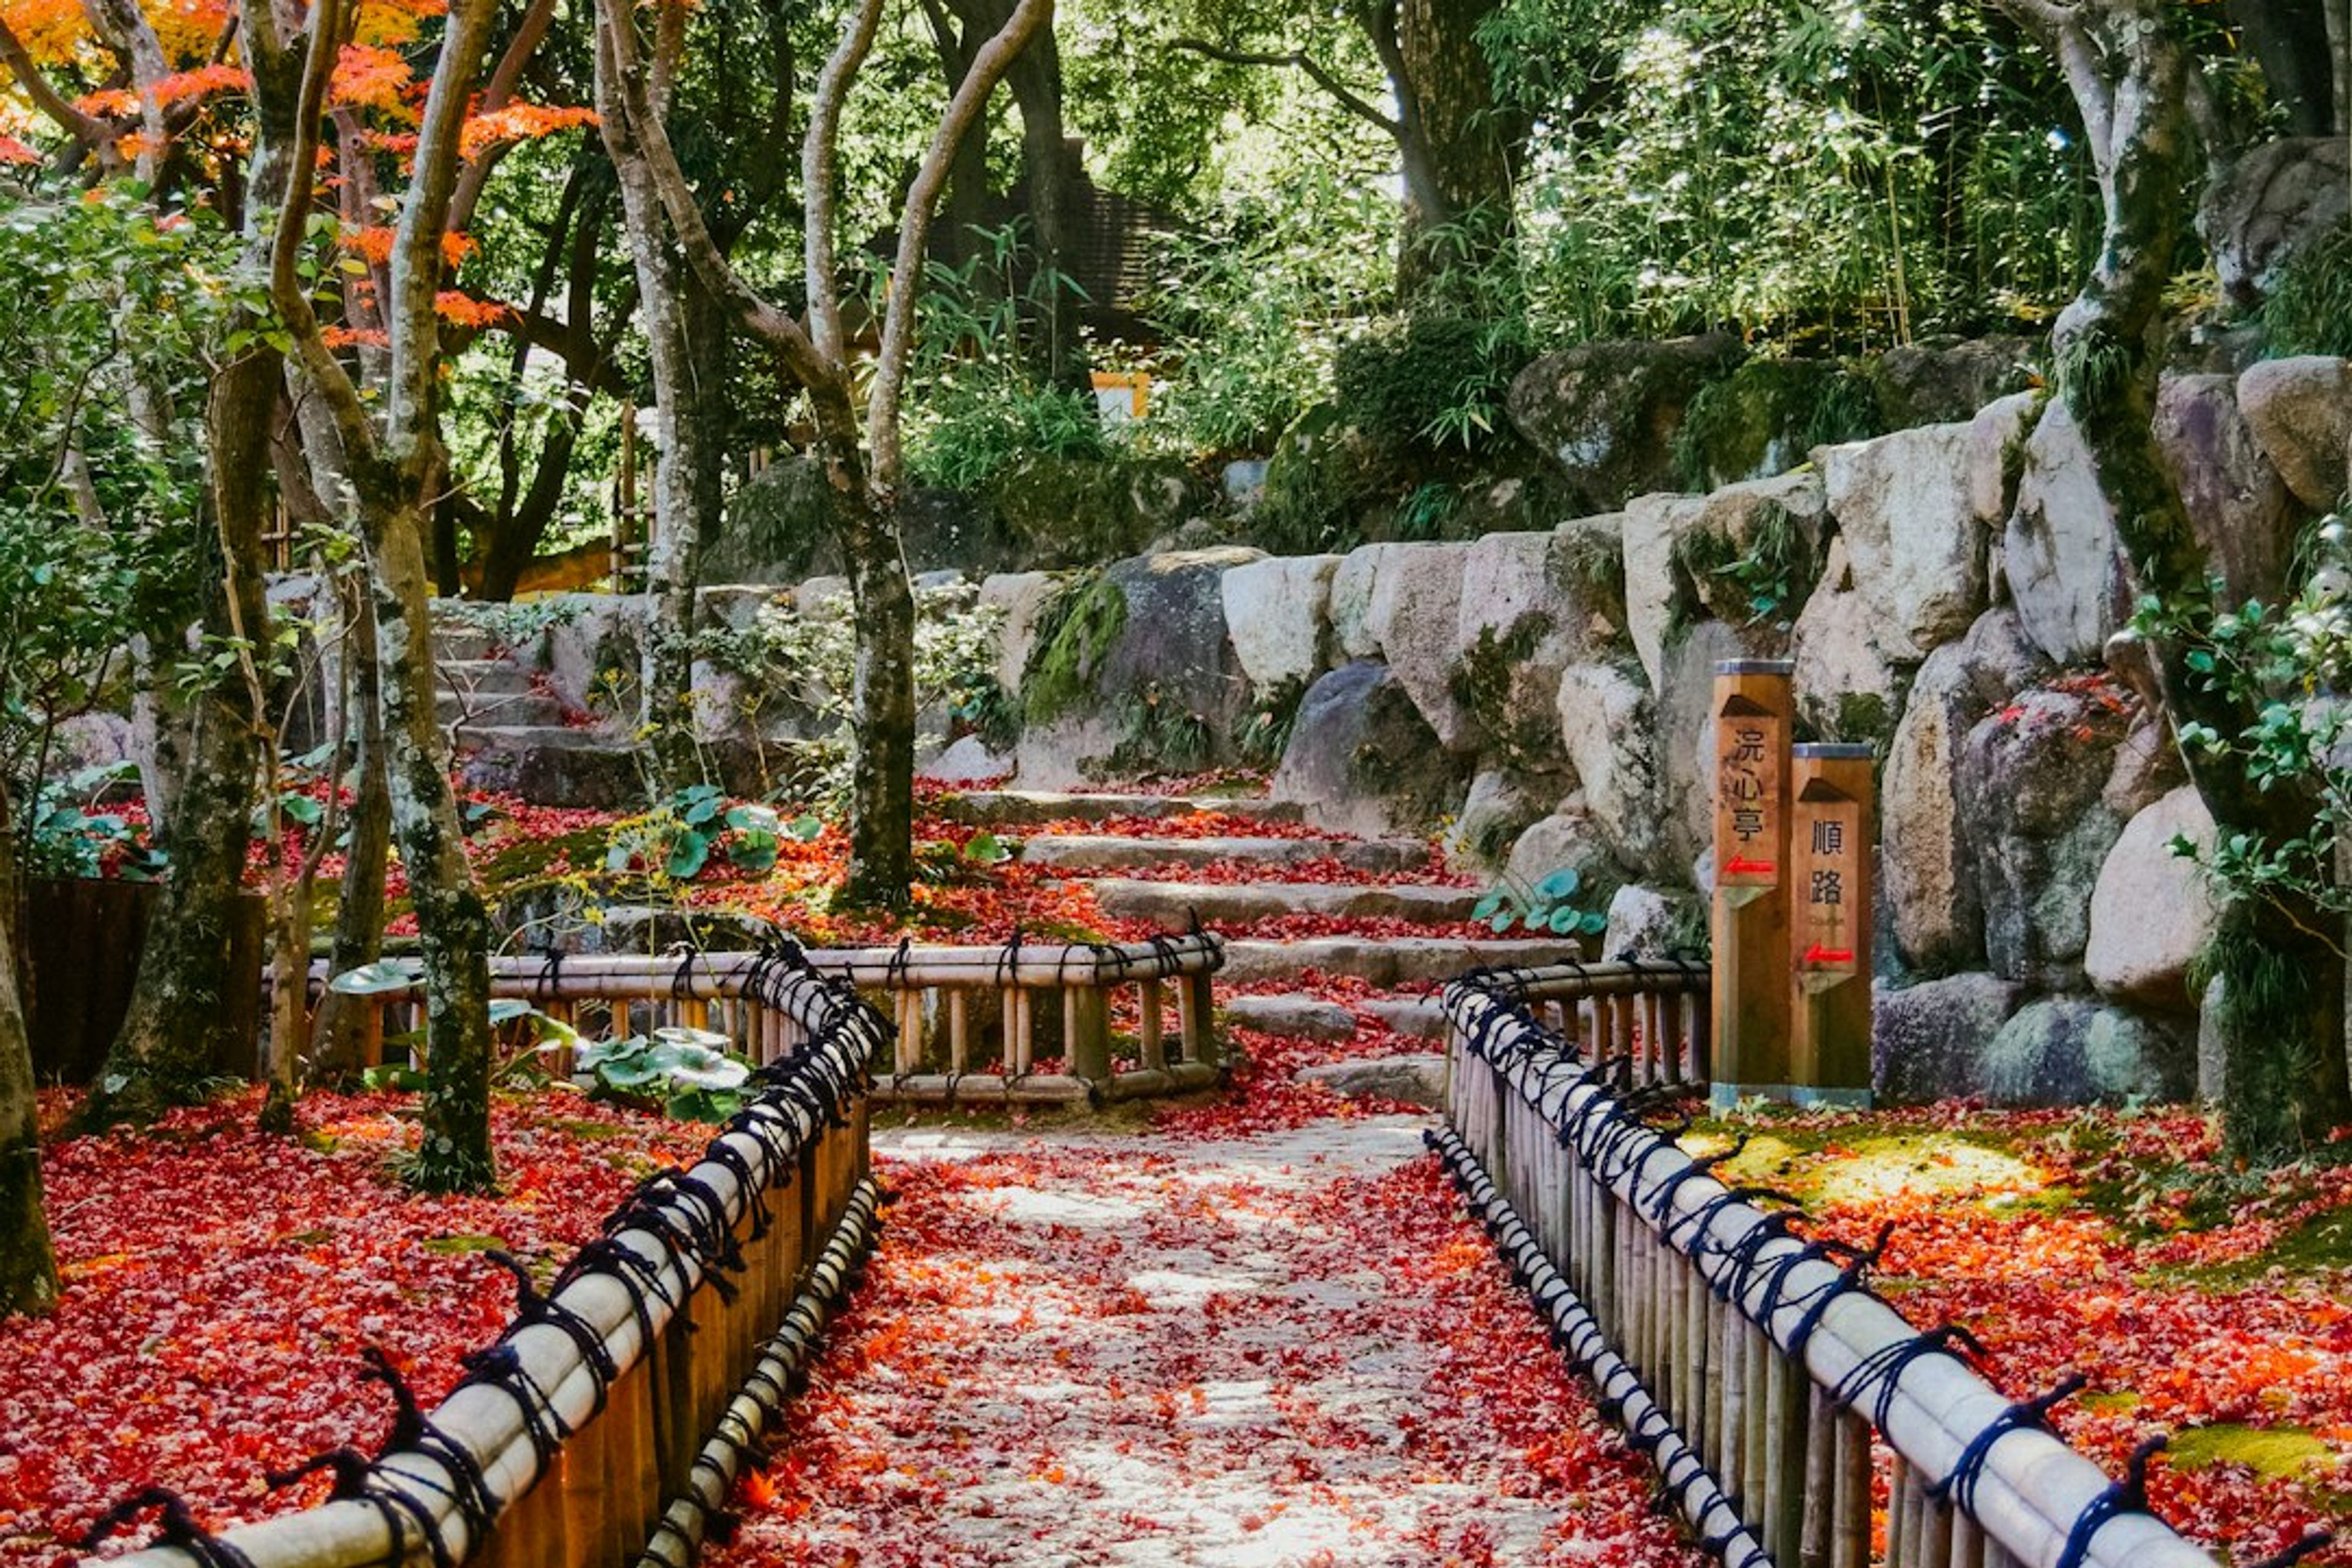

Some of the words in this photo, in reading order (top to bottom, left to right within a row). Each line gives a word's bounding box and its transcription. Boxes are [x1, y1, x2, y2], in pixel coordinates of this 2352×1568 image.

[1733, 729, 1765, 842] 浣心亭
[1812, 820, 1843, 904] 順路
